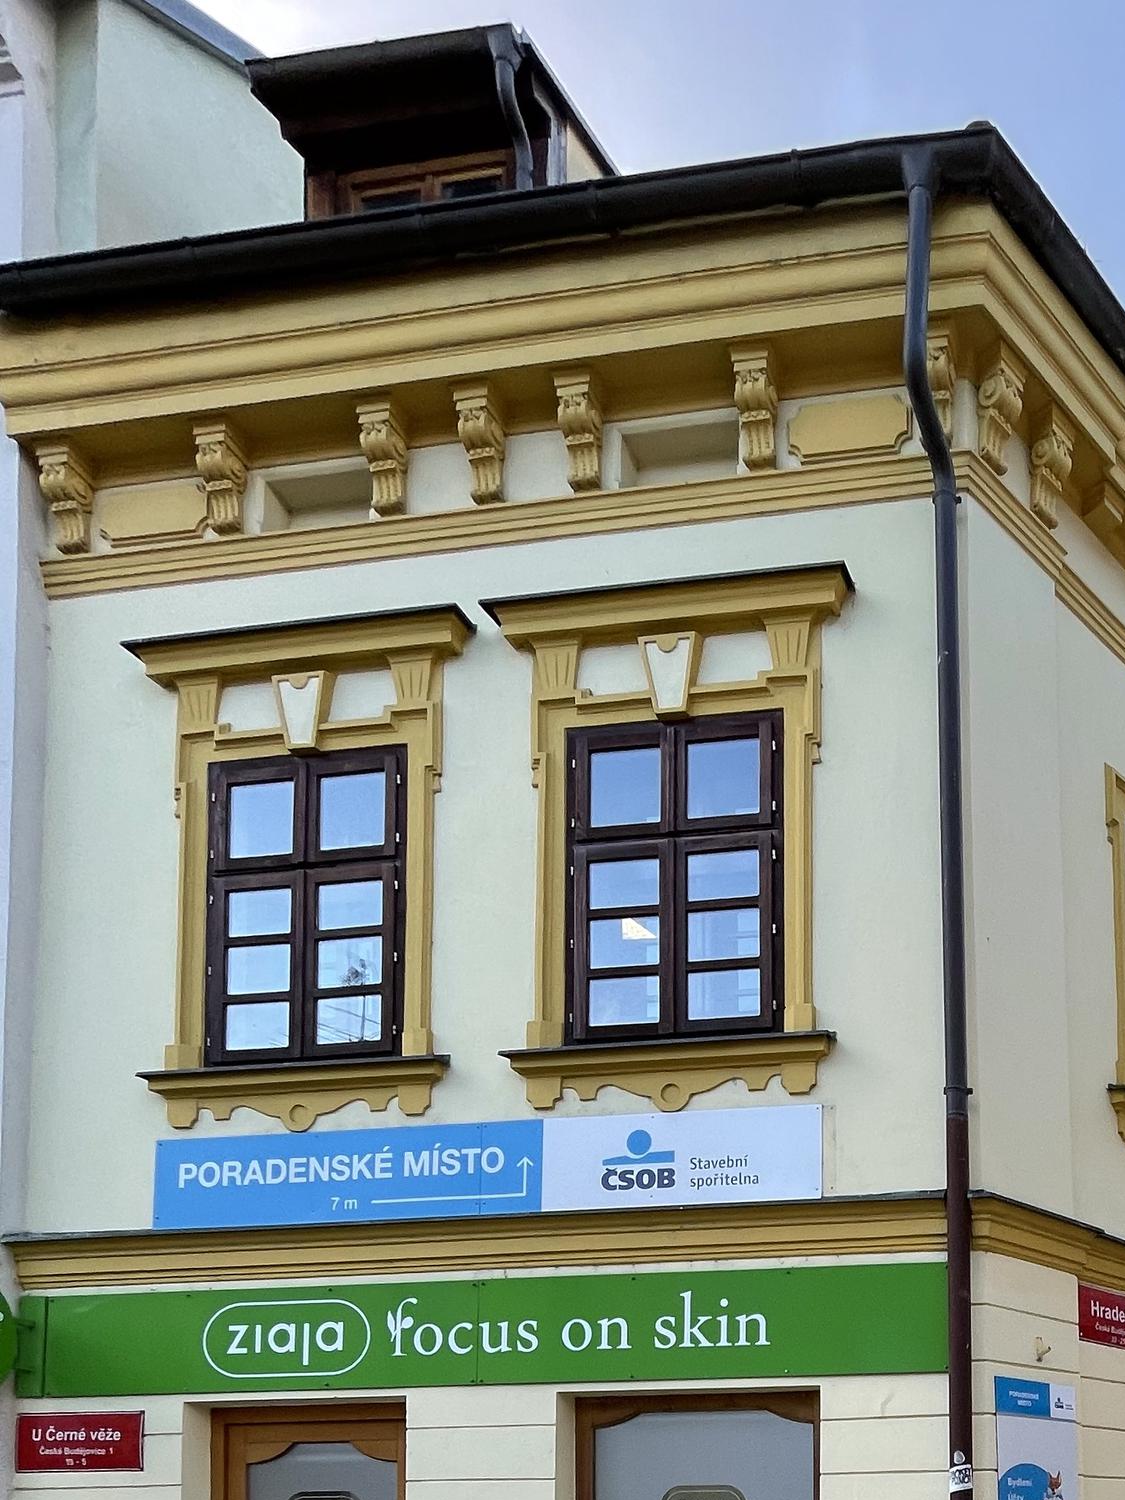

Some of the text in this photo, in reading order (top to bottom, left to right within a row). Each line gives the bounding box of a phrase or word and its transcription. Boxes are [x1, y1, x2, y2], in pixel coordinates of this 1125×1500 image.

[178, 1143, 505, 1188] PORADENSKÉ MÍSTO
[690, 1155, 748, 1171] Stavební
[601, 1167, 676, 1191] ČSOB
[690, 1171, 760, 1188] spořitelna
[330, 1197, 358, 1211] 7 m
[226, 1290, 770, 1366] ziaja focus on skin
[32, 1425, 121, 1441] U Černé věže
